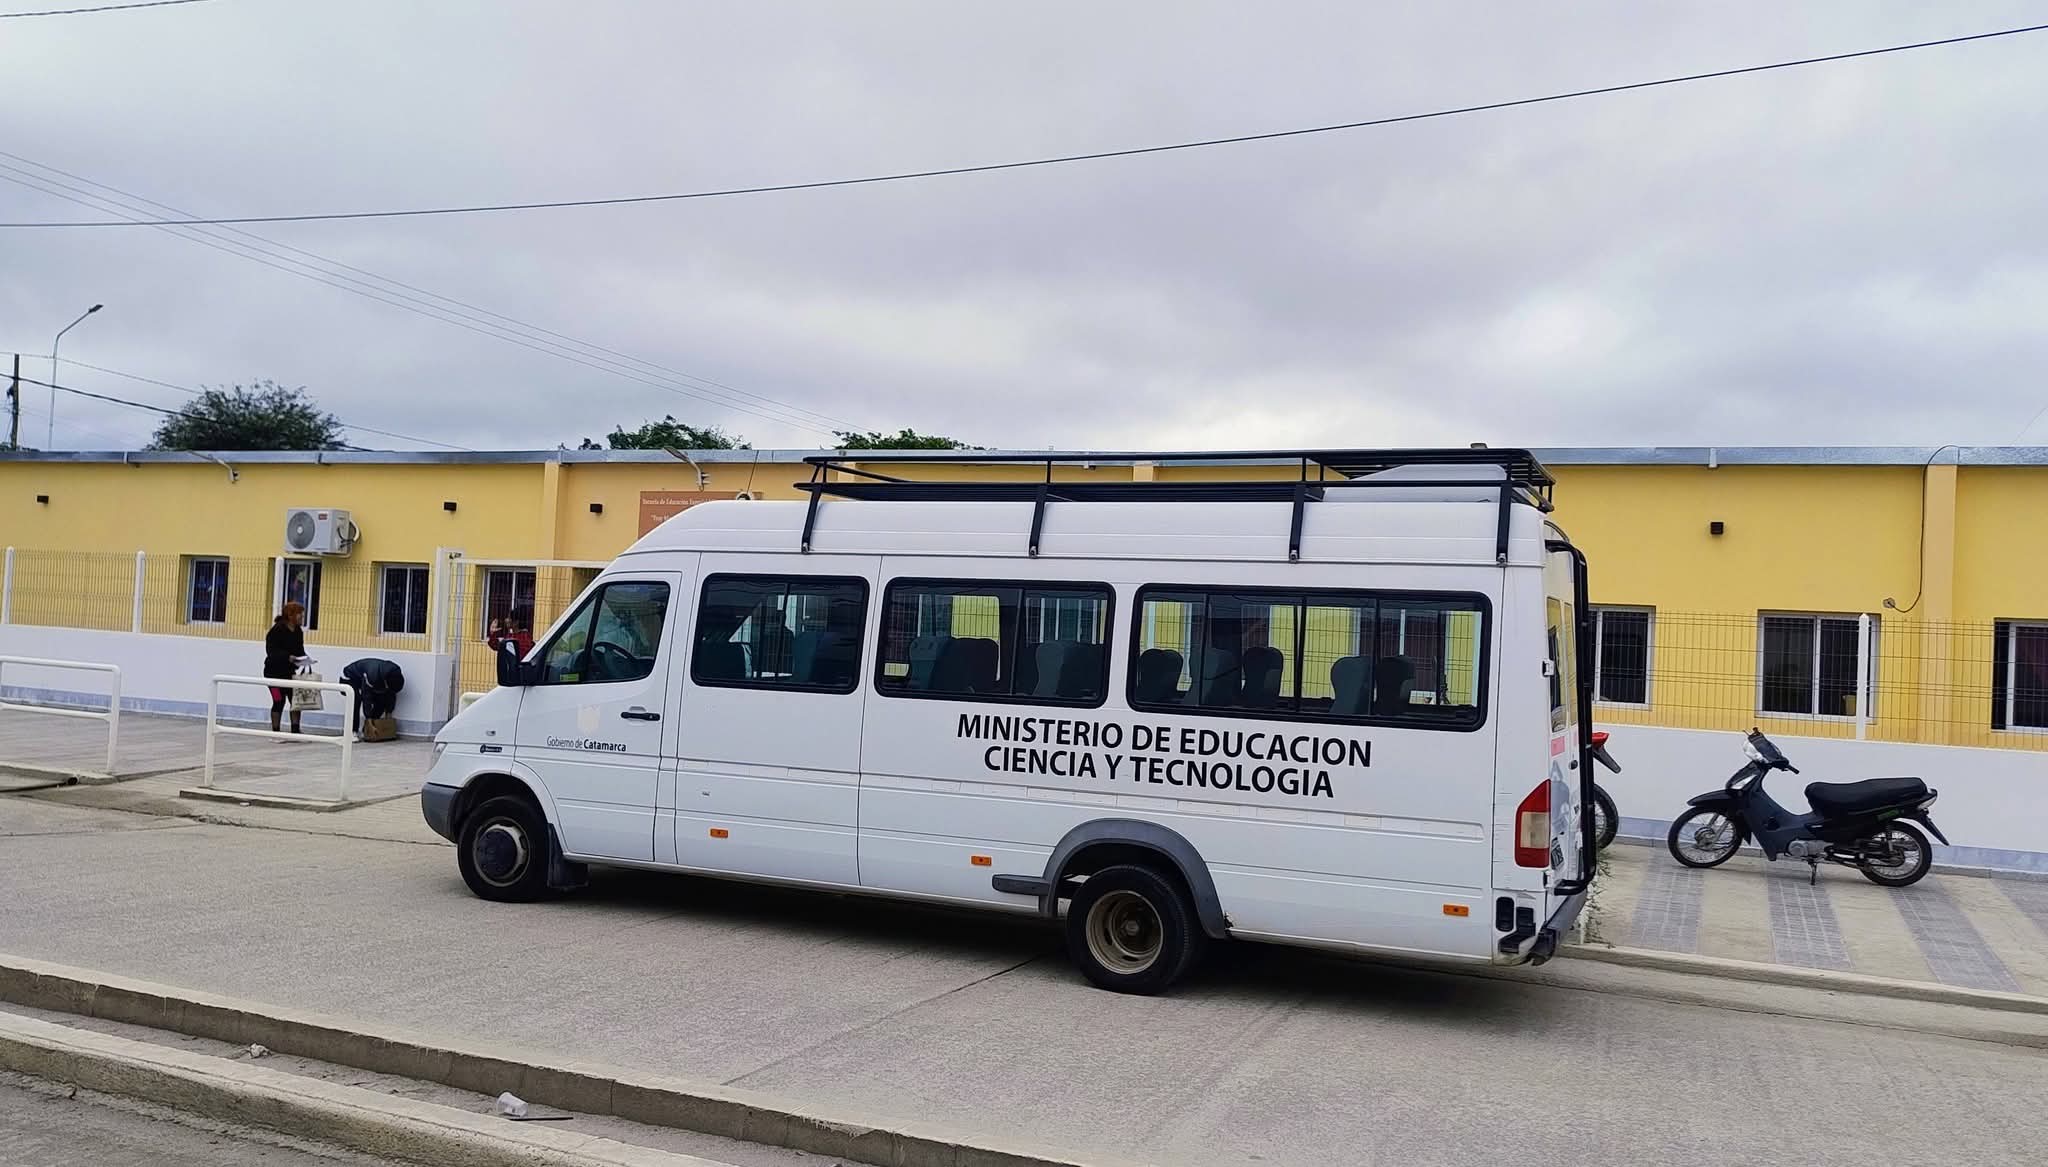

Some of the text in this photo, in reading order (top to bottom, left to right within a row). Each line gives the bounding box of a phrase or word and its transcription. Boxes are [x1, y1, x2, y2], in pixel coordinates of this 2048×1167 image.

[547, 736, 627, 752] Gobierno de Catamarca
[957, 713, 1372, 768] MINISTERIO DE EDUCACION
[984, 745, 1334, 799] CIENCIA Y TECNOLOGIA
